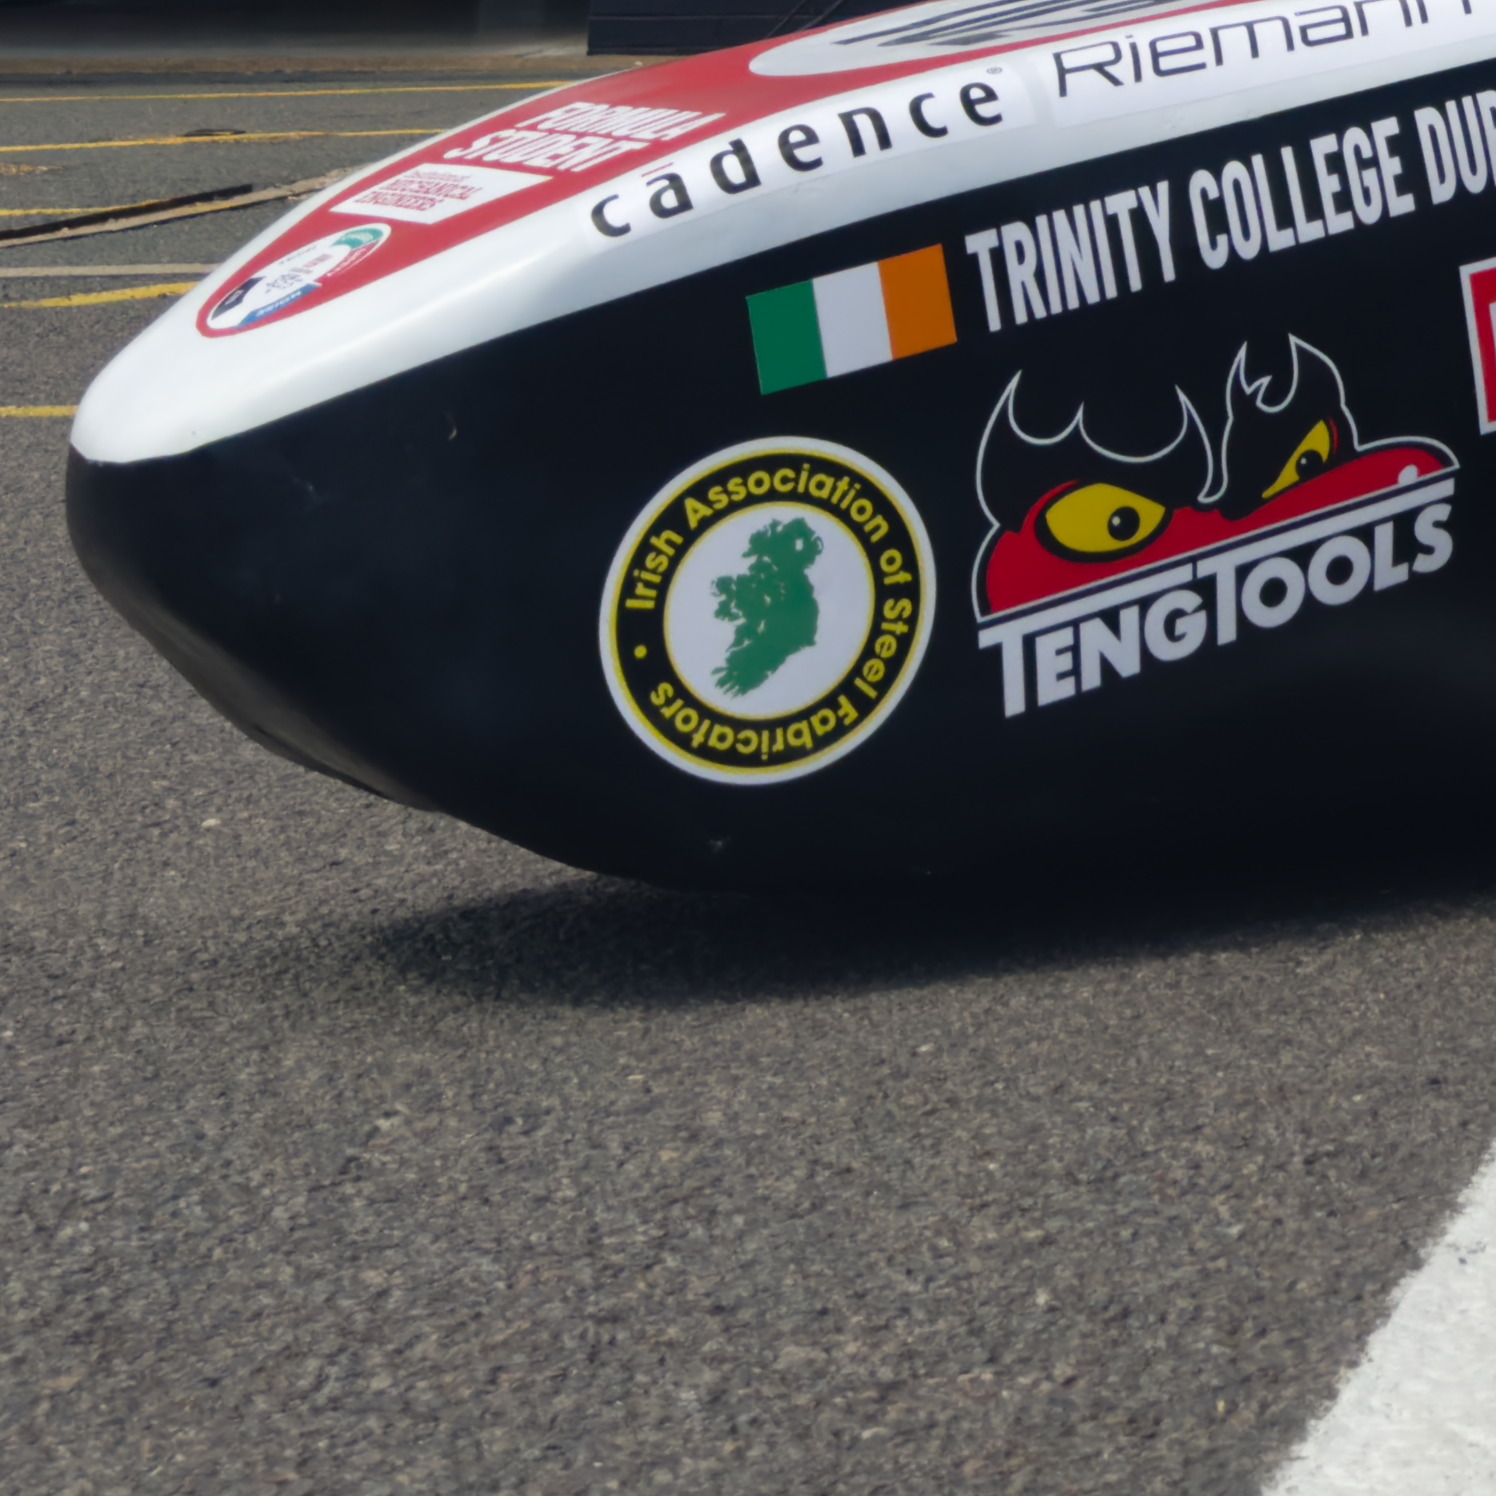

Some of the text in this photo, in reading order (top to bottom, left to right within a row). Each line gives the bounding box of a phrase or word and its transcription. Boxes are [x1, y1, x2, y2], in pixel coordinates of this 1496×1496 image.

[443, 128, 653, 173] STUDENT
[515, 101, 727, 142] FORMULA
[965, 180, 1175, 332] TRINITY
[1189, 116, 1416, 270] COLLEGE
[625, 463, 913, 761] Irish Association of Steel Fabricators
